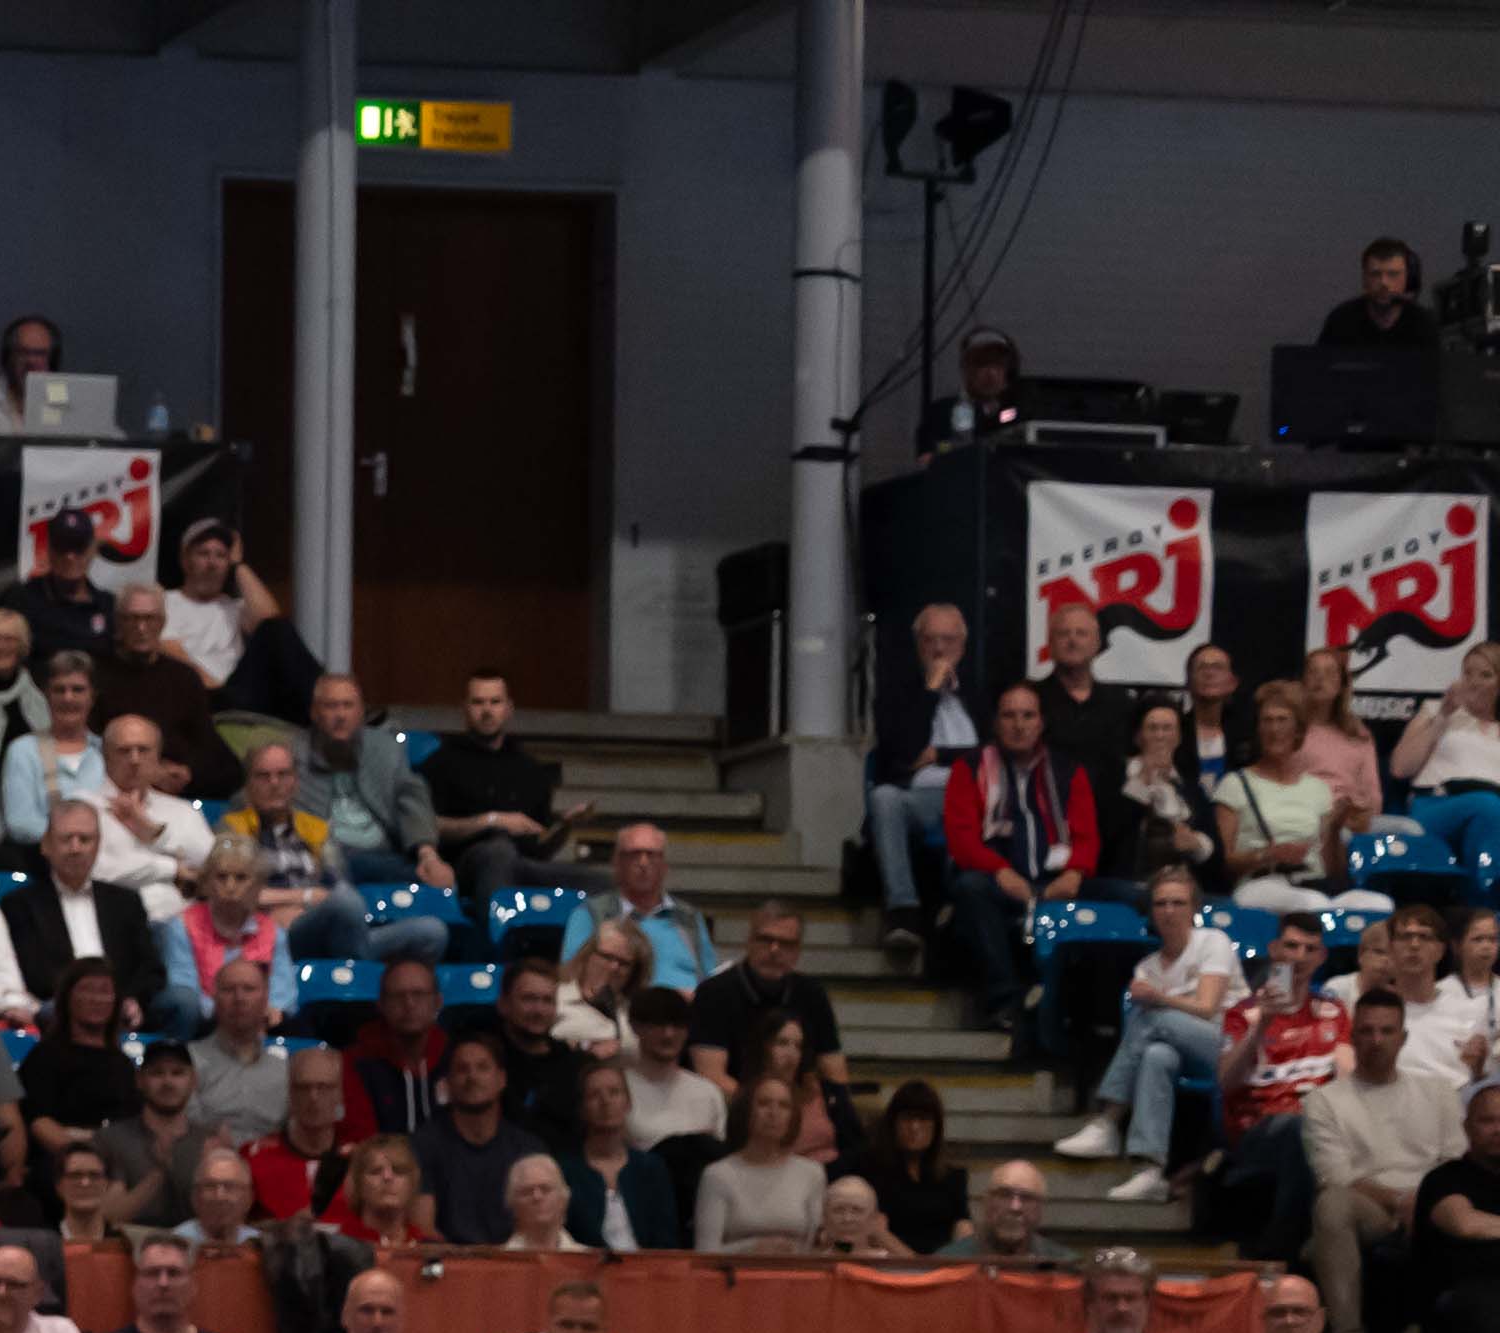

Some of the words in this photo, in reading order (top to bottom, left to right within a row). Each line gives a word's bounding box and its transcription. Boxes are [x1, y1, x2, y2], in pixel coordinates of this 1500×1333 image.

[1036, 498, 1199, 662] NRJ
[1037, 524, 1163, 576] ENERGY
[1318, 530, 1443, 584] ENERGY
[1318, 503, 1478, 647] NRJ
